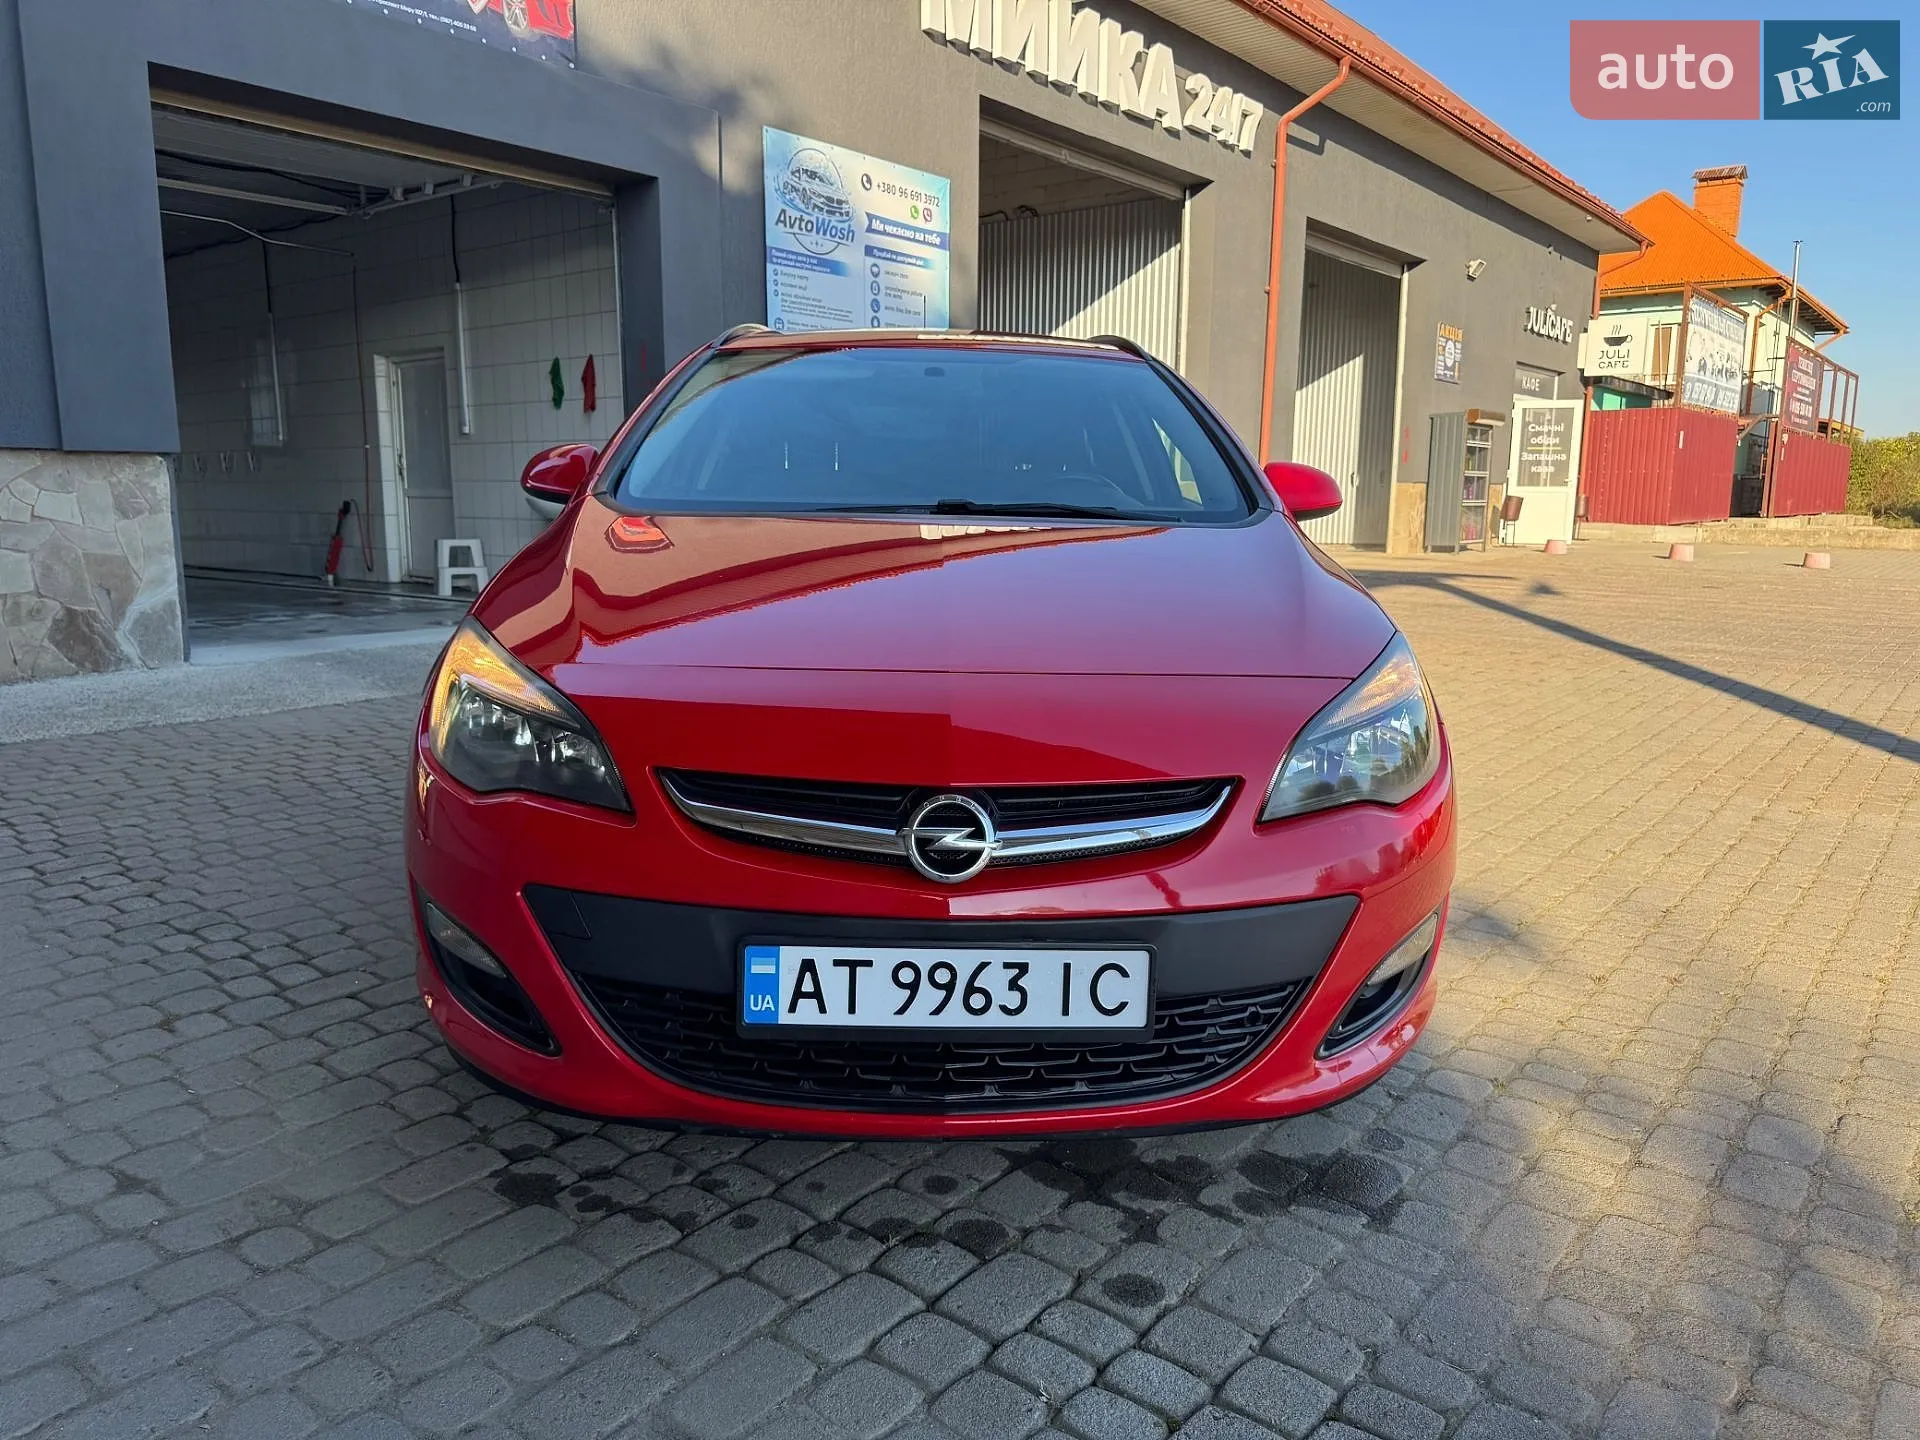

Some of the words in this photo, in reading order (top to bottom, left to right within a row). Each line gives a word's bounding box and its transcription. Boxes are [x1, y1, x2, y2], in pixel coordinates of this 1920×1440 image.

[877, 182, 896, 196] +380
[899, 186, 909, 199] 96
[910, 189, 922, 204] 691
[924, 193, 941, 208] 3972
[774, 208, 856, 243] AvtoWash
[1598, 348, 1631, 360] JULI
[1598, 360, 1631, 370] CAFE
[1528, 422, 1565, 432] Смачні
[1521, 452, 1567, 461] Запашна
[1531, 465, 1556, 473] кава
[787, 958, 874, 1015] AT
[891, 960, 1031, 1017] 9963
[1061, 962, 1131, 1017] IC
[749, 993, 776, 1013] UA
